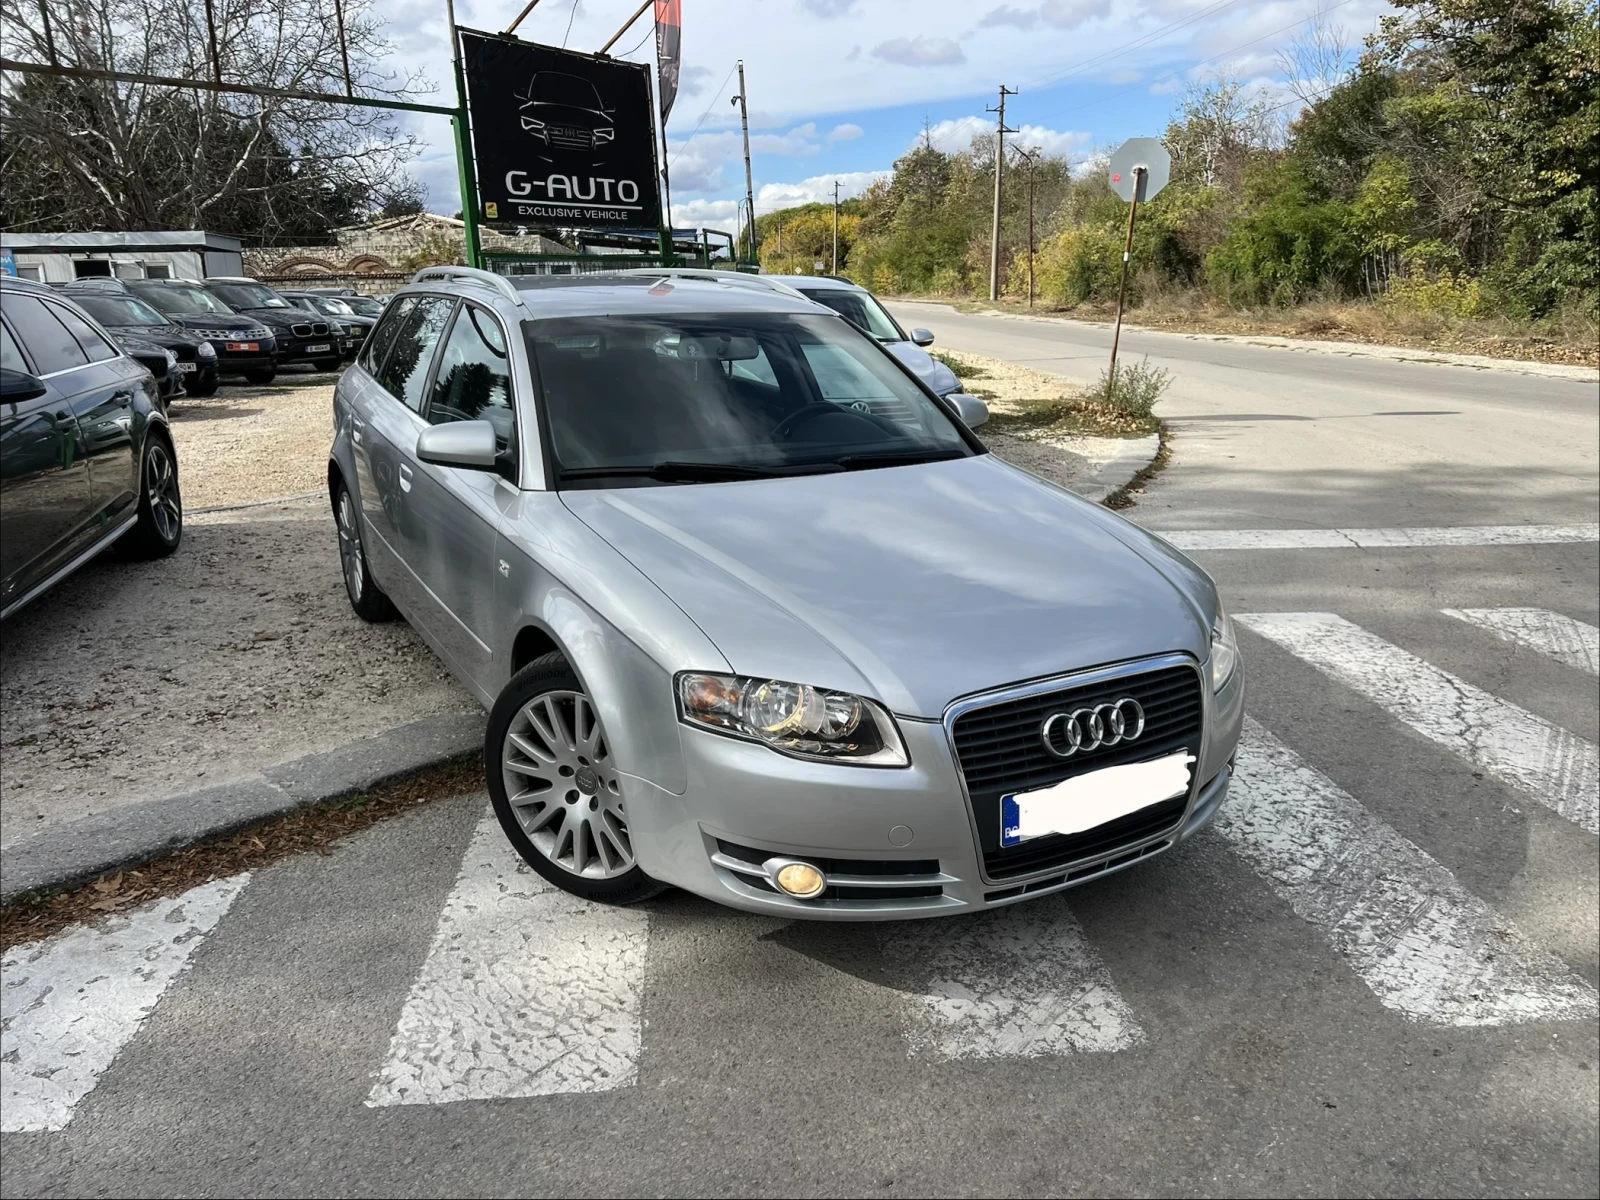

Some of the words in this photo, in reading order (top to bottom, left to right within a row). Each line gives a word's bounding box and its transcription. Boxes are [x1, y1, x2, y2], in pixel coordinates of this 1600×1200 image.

[505, 170, 639, 202] G-AUTO
[518, 206, 581, 218] EXCLUSIVE
[584, 210, 628, 220] VEHICLE
